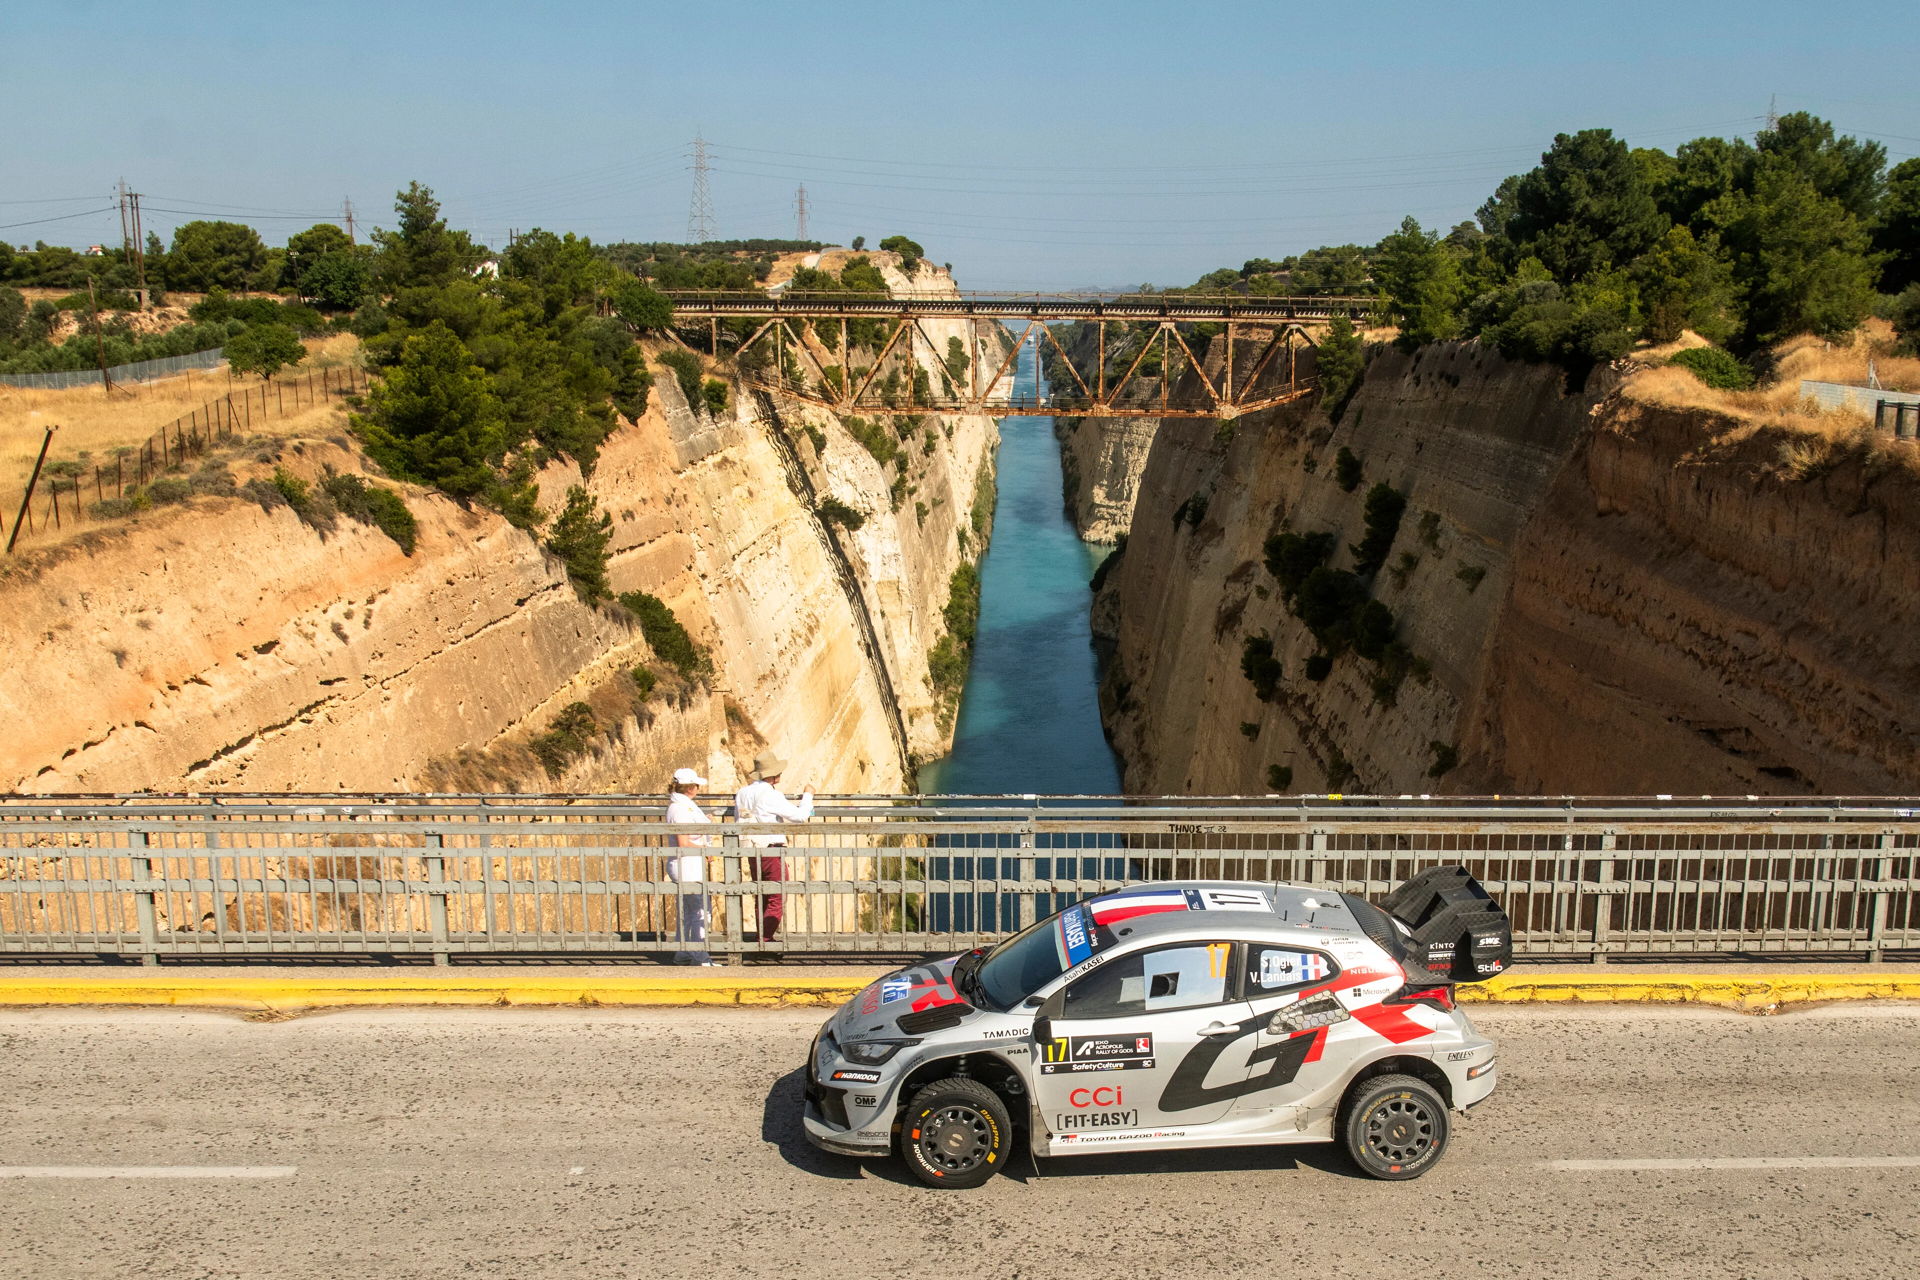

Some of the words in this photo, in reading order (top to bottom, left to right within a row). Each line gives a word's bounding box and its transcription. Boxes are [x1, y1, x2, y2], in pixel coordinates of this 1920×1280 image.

[1429, 942, 1455, 950] KINTO
[1206, 943, 1231, 979] 17
[1063, 956, 1105, 983] AsahiKASEI
[1477, 960, 1503, 973] Stilo
[1363, 987, 1391, 995] Microsoft
[1047, 1038, 1068, 1063] 17
[1448, 1050, 1475, 1060] ENDLESS
[1072, 1062, 1125, 1071] SafetyCulture
[855, 1096, 877, 1106] OMP
